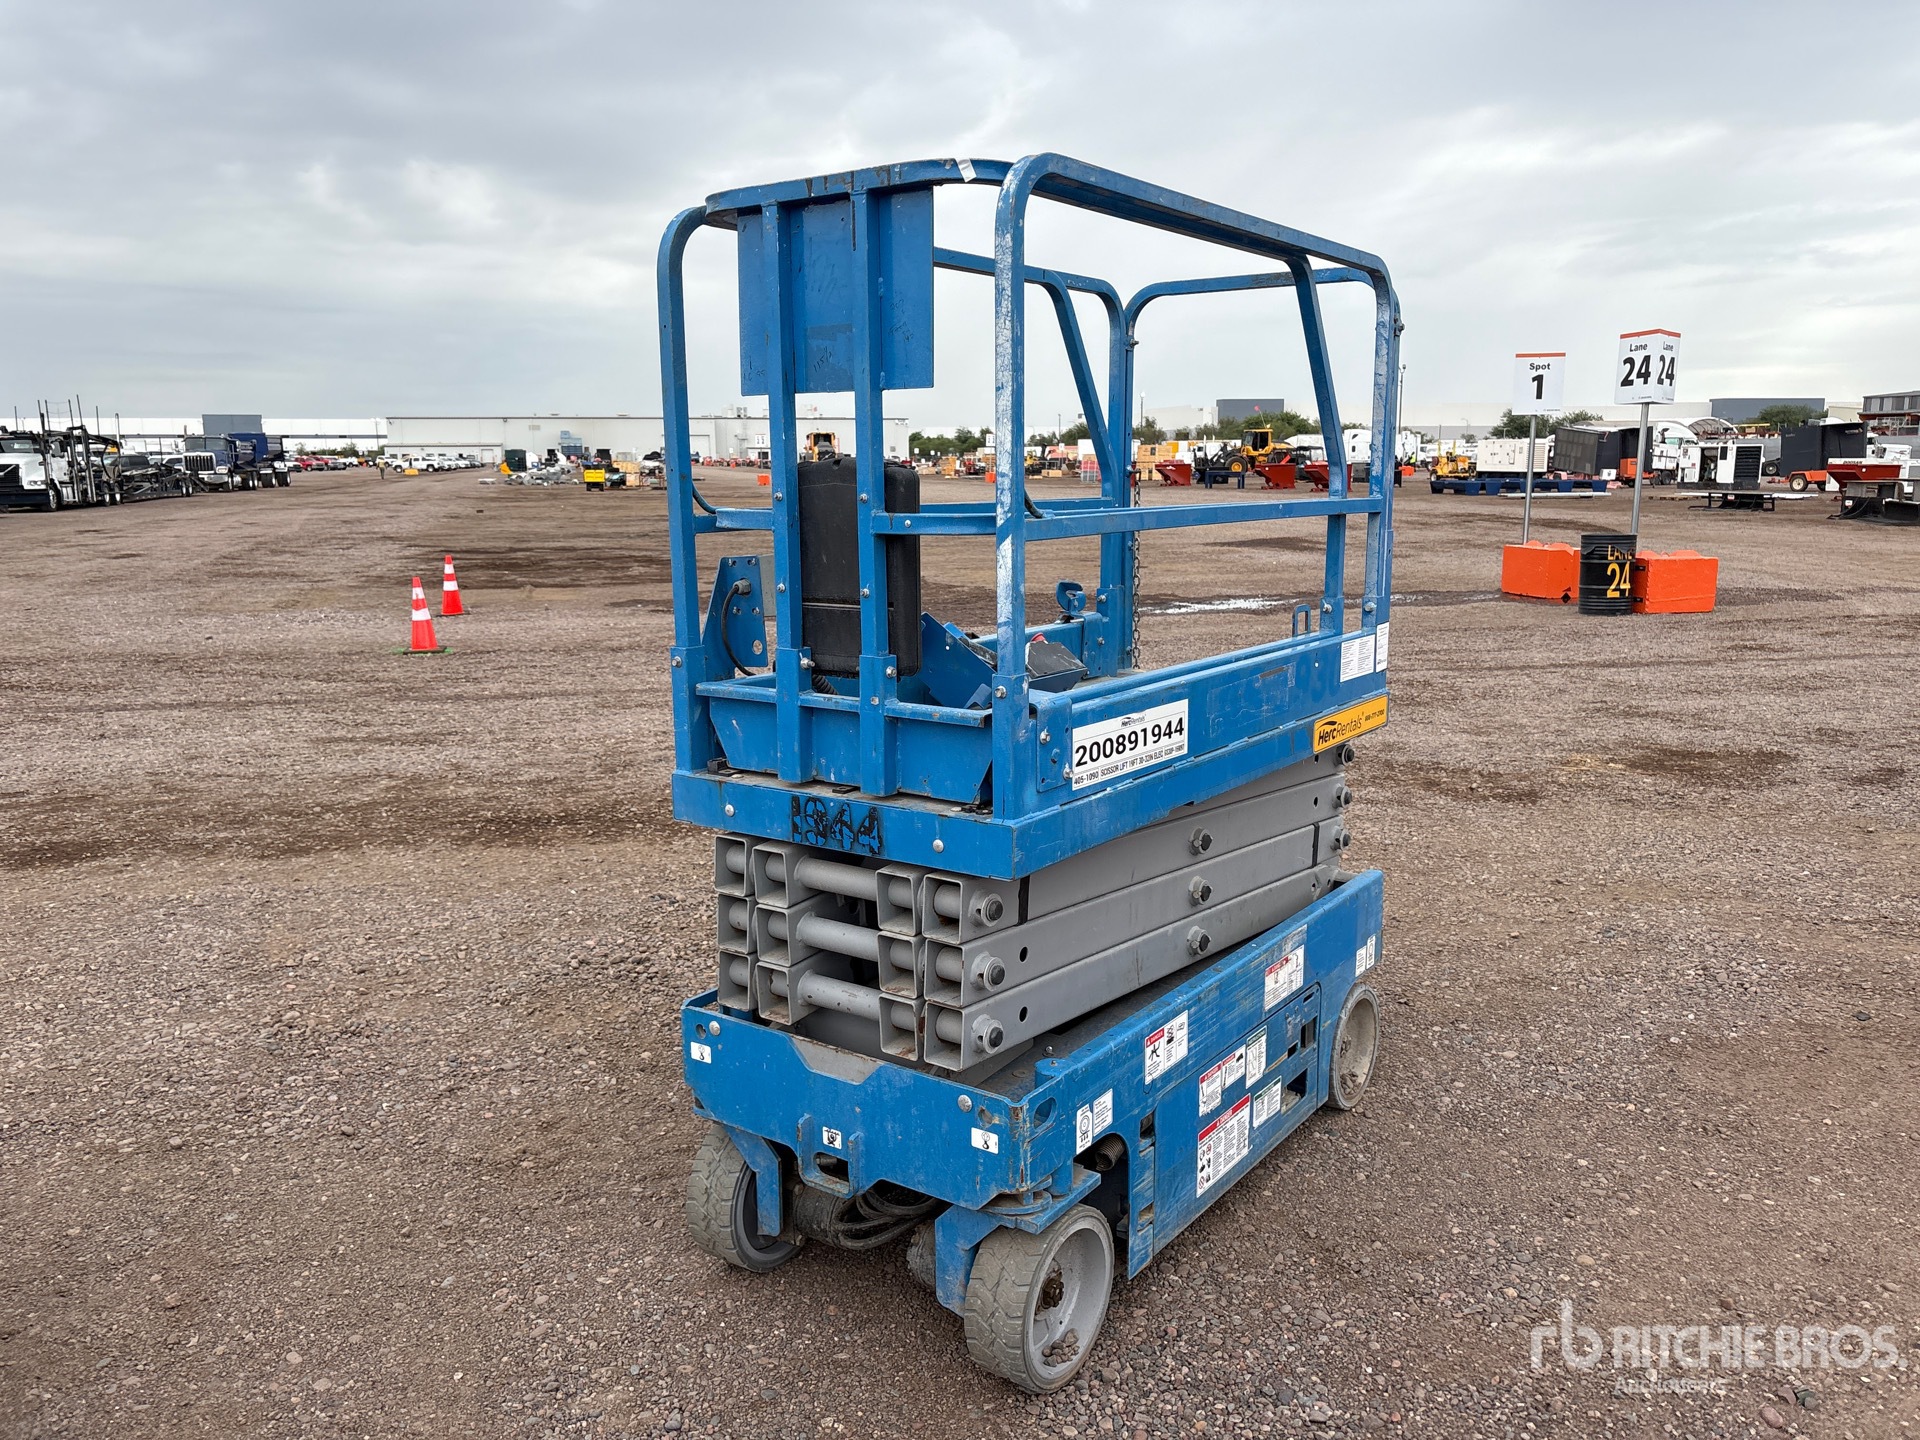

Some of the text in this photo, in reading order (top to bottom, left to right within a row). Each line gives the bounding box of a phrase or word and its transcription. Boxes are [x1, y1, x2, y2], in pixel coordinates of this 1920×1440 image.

[1629, 343, 1648, 352] Lane
[1662, 341, 1674, 351] Lane
[1529, 362, 1551, 372] Spot
[1620, 354, 1651, 387] 24
[1657, 354, 1675, 387] 24
[1531, 374, 1544, 400] 1
[1607, 560, 1631, 598] 24
[1075, 717, 1184, 767] 200891944
[1318, 715, 1363, 746] HercRentals
[1101, 764, 1119, 777] SCISSOR
[1120, 761, 1128, 771] LIFT
[1154, 750, 1163, 760] ELEC
[1074, 771, 1099, 785] 405-1090
